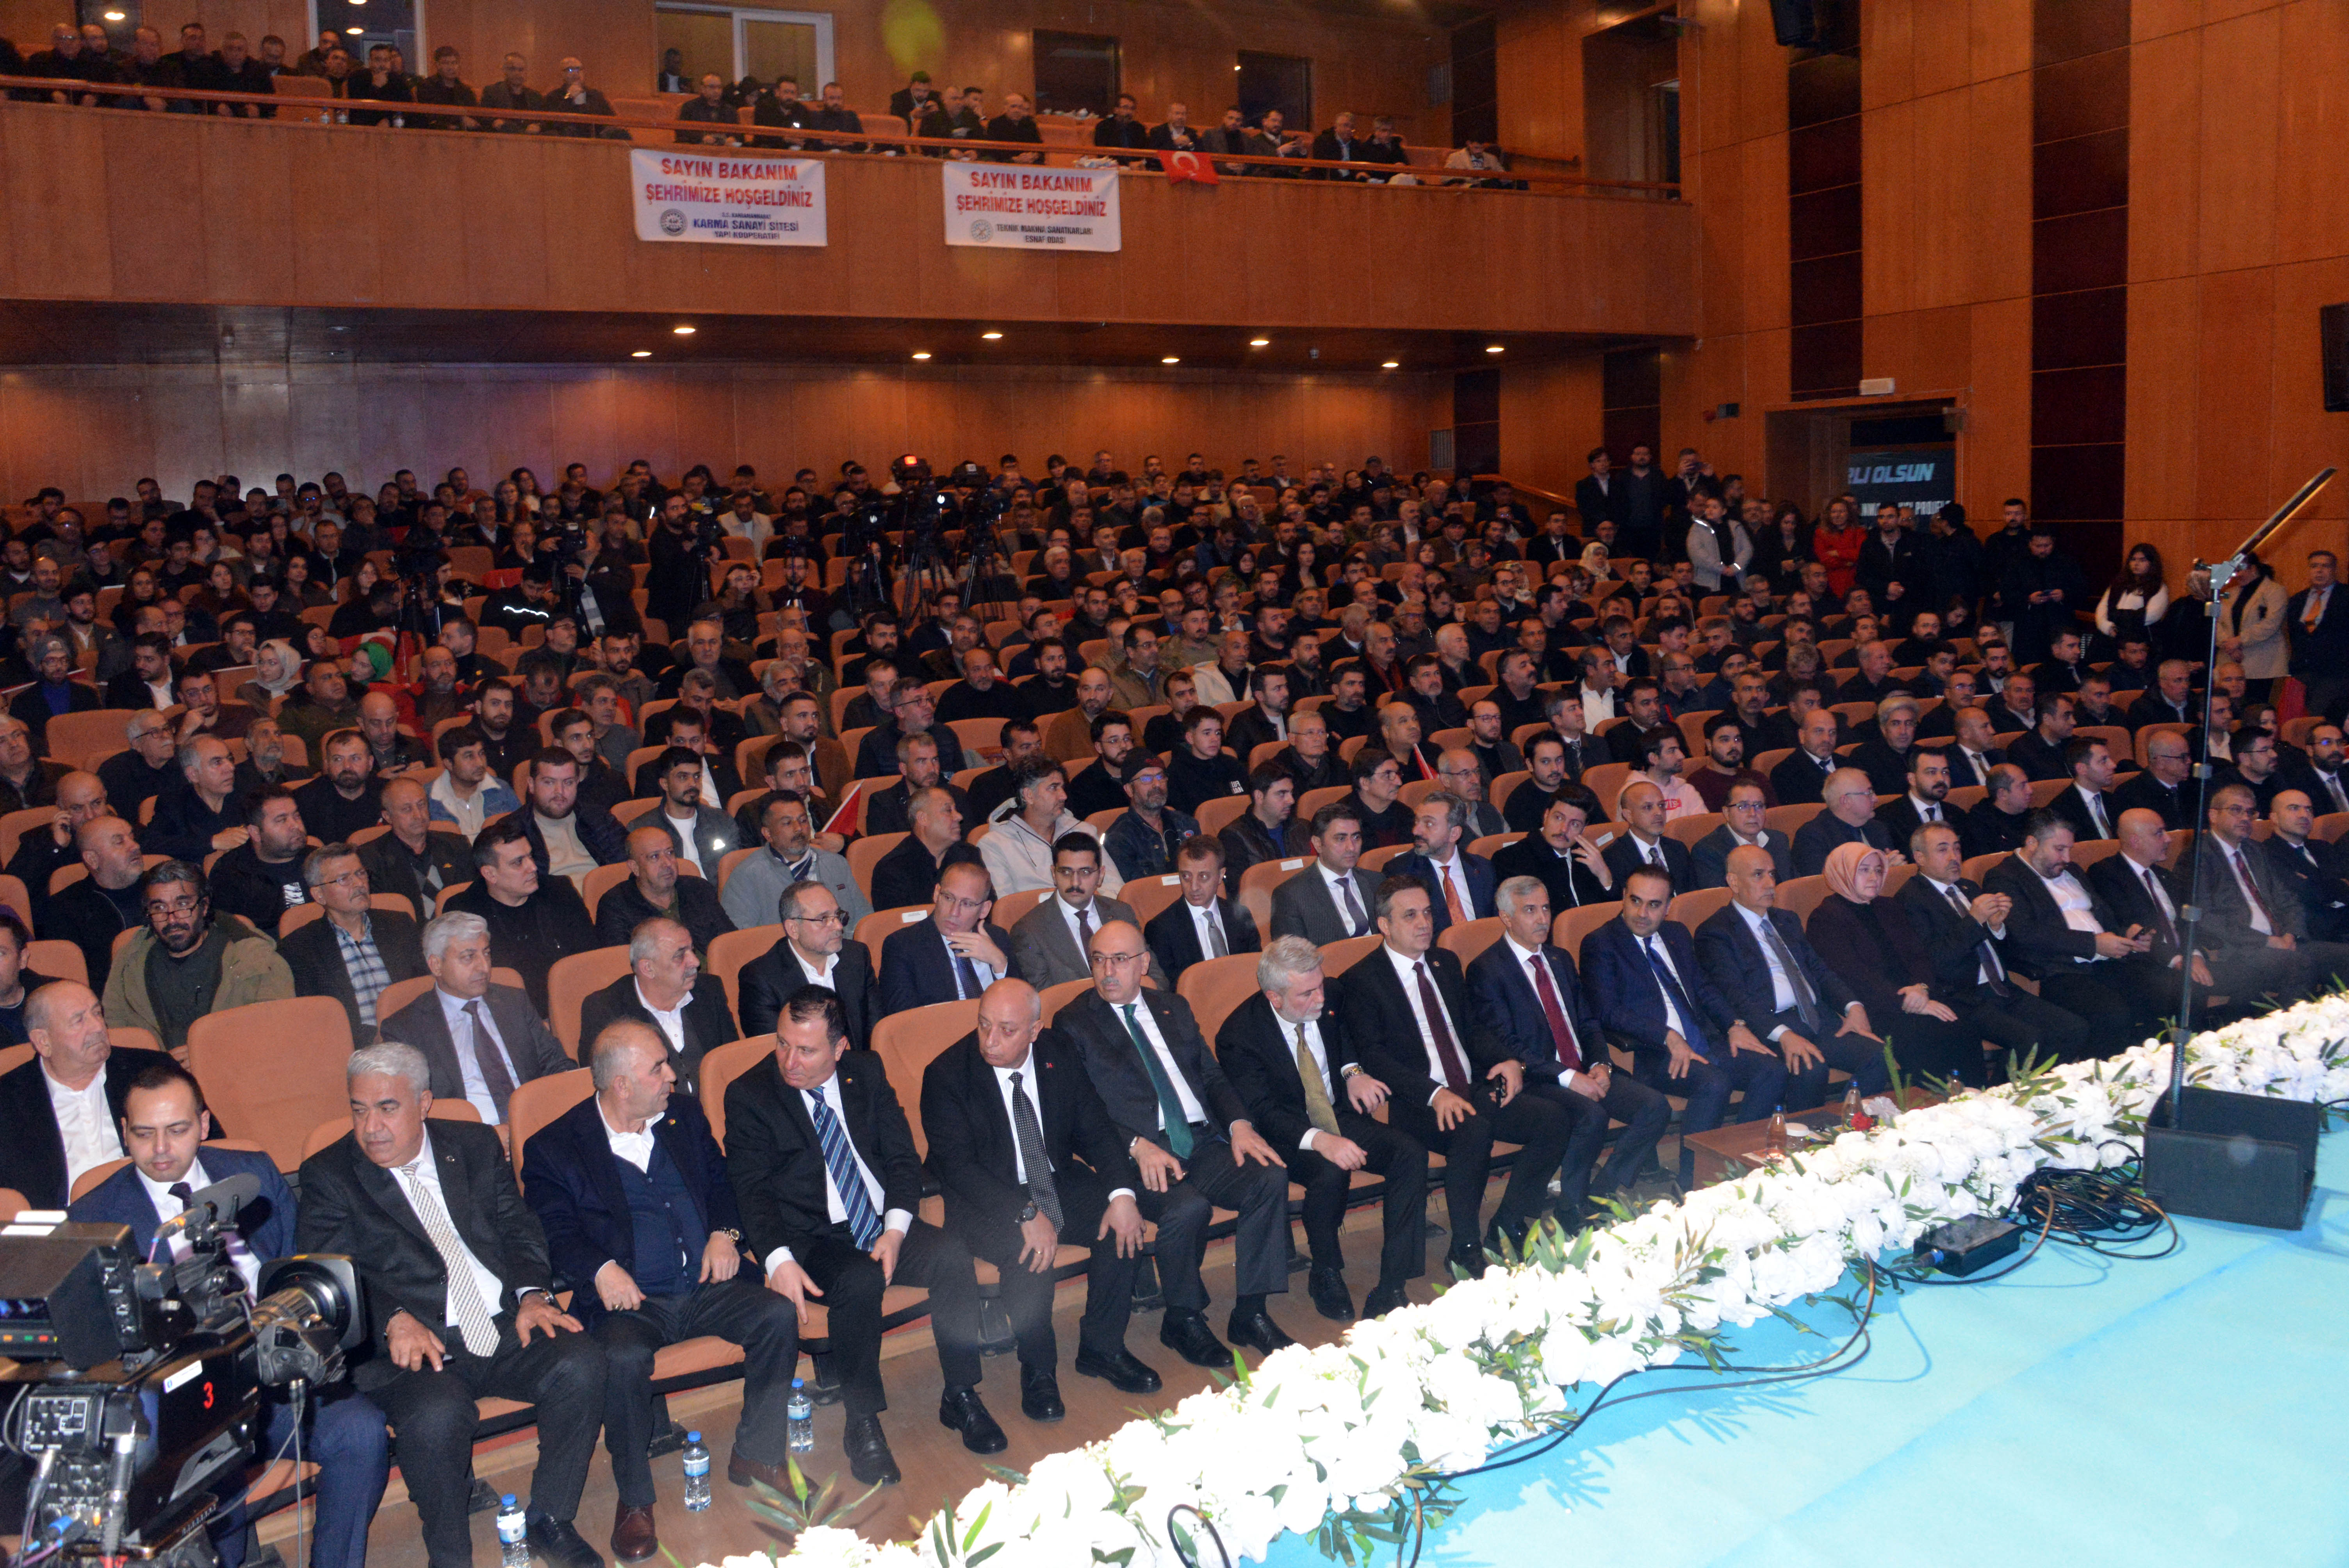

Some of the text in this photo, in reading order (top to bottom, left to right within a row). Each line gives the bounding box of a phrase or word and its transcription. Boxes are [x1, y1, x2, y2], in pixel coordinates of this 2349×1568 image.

[661, 158, 798, 180] SAYIN BAKANIM
[971, 171, 1093, 192] SAYIN BAKANIM
[646, 180, 813, 208] ŞEHRİMİZE HOŞGELDİNİZ
[957, 191, 1107, 219] ŞEHRİMİZE HOŞGELDİNİZ
[693, 219, 799, 231] KARMA SANAYİ SİTESİ
[1871, 463, 1935, 483] OLSUN
[203, 1381, 214, 1409] 3
